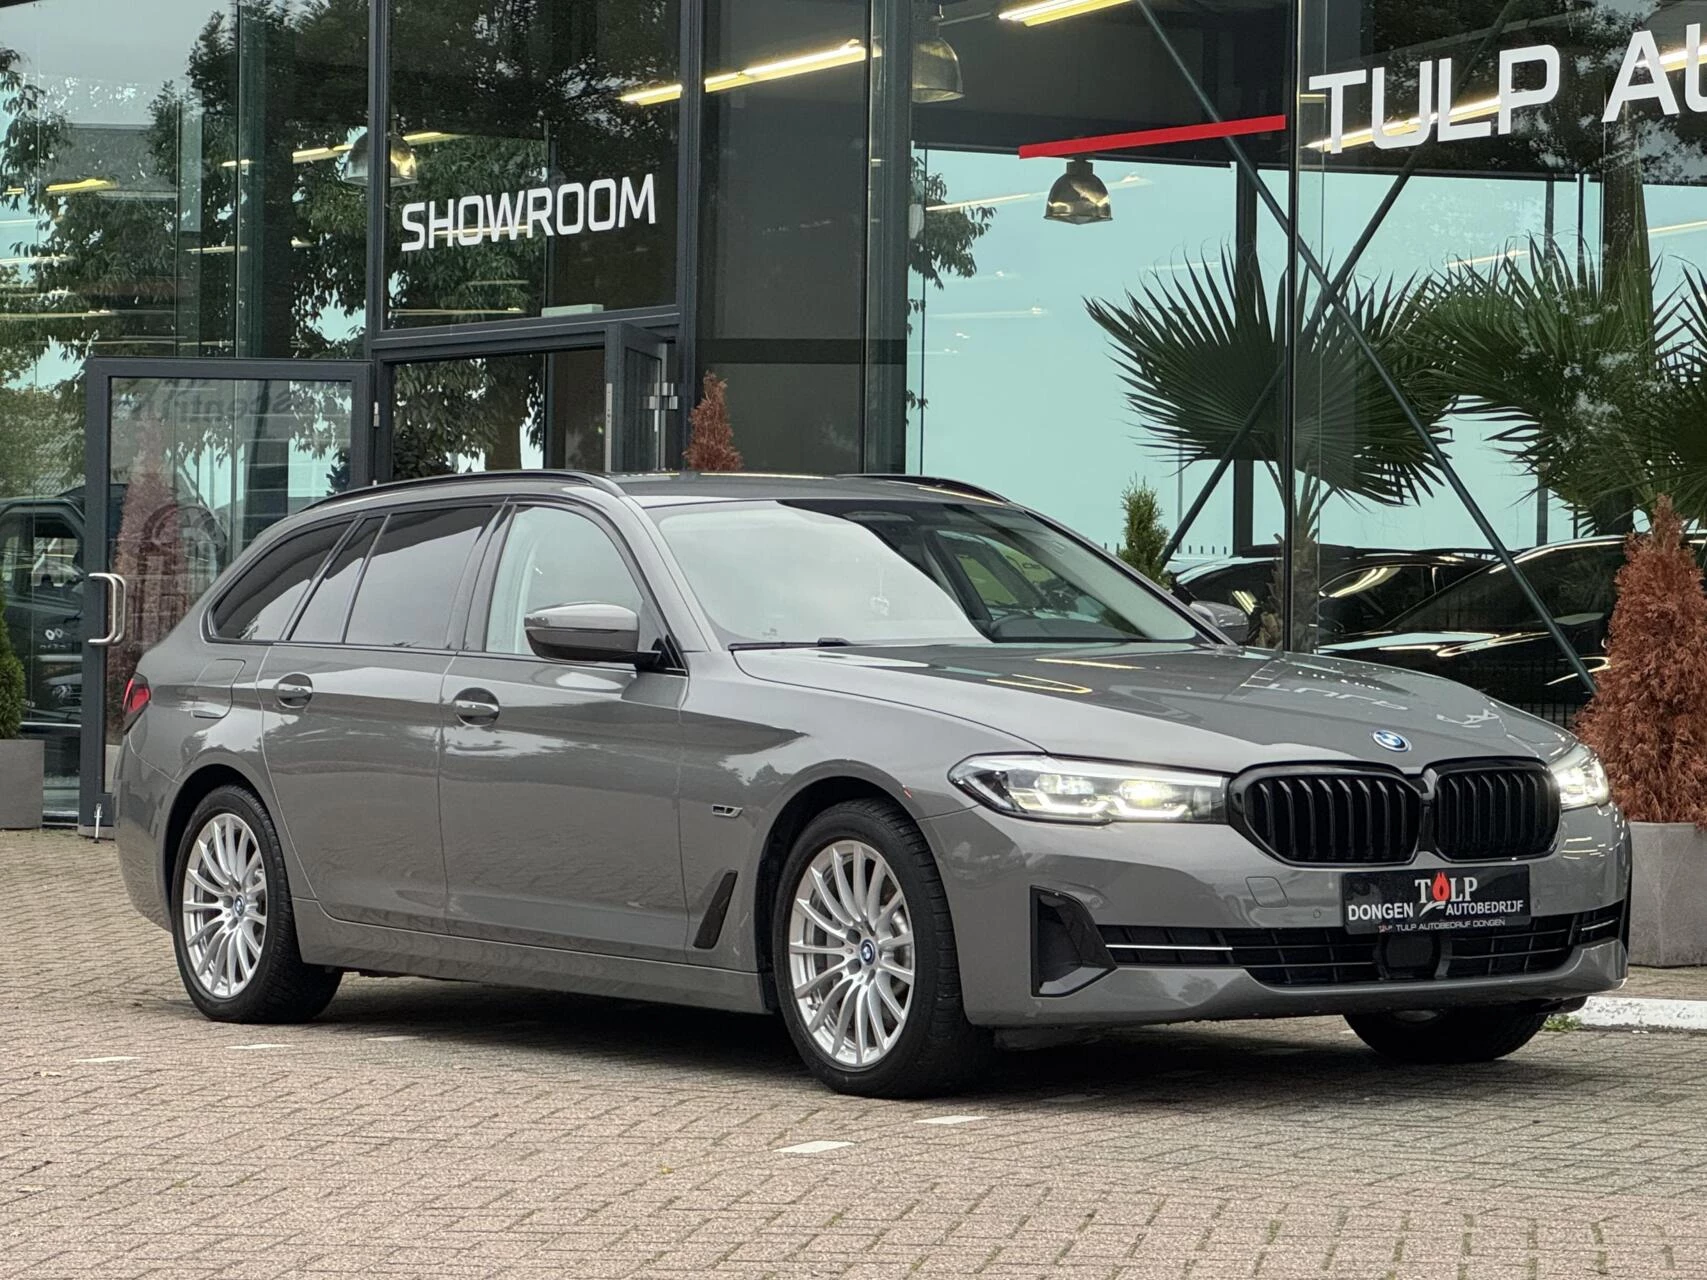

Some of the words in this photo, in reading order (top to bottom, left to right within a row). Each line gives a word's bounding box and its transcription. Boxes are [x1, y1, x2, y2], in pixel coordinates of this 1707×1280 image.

[1309, 44, 1560, 154] TULP
[401, 173, 656, 251] SHOWROOM
[1348, 902, 1414, 920] DONGEN
[1445, 899, 1524, 916] AUTOBEDRIJF
[1396, 923, 1417, 932] TULP
[1472, 918, 1506, 928] DONGEN
